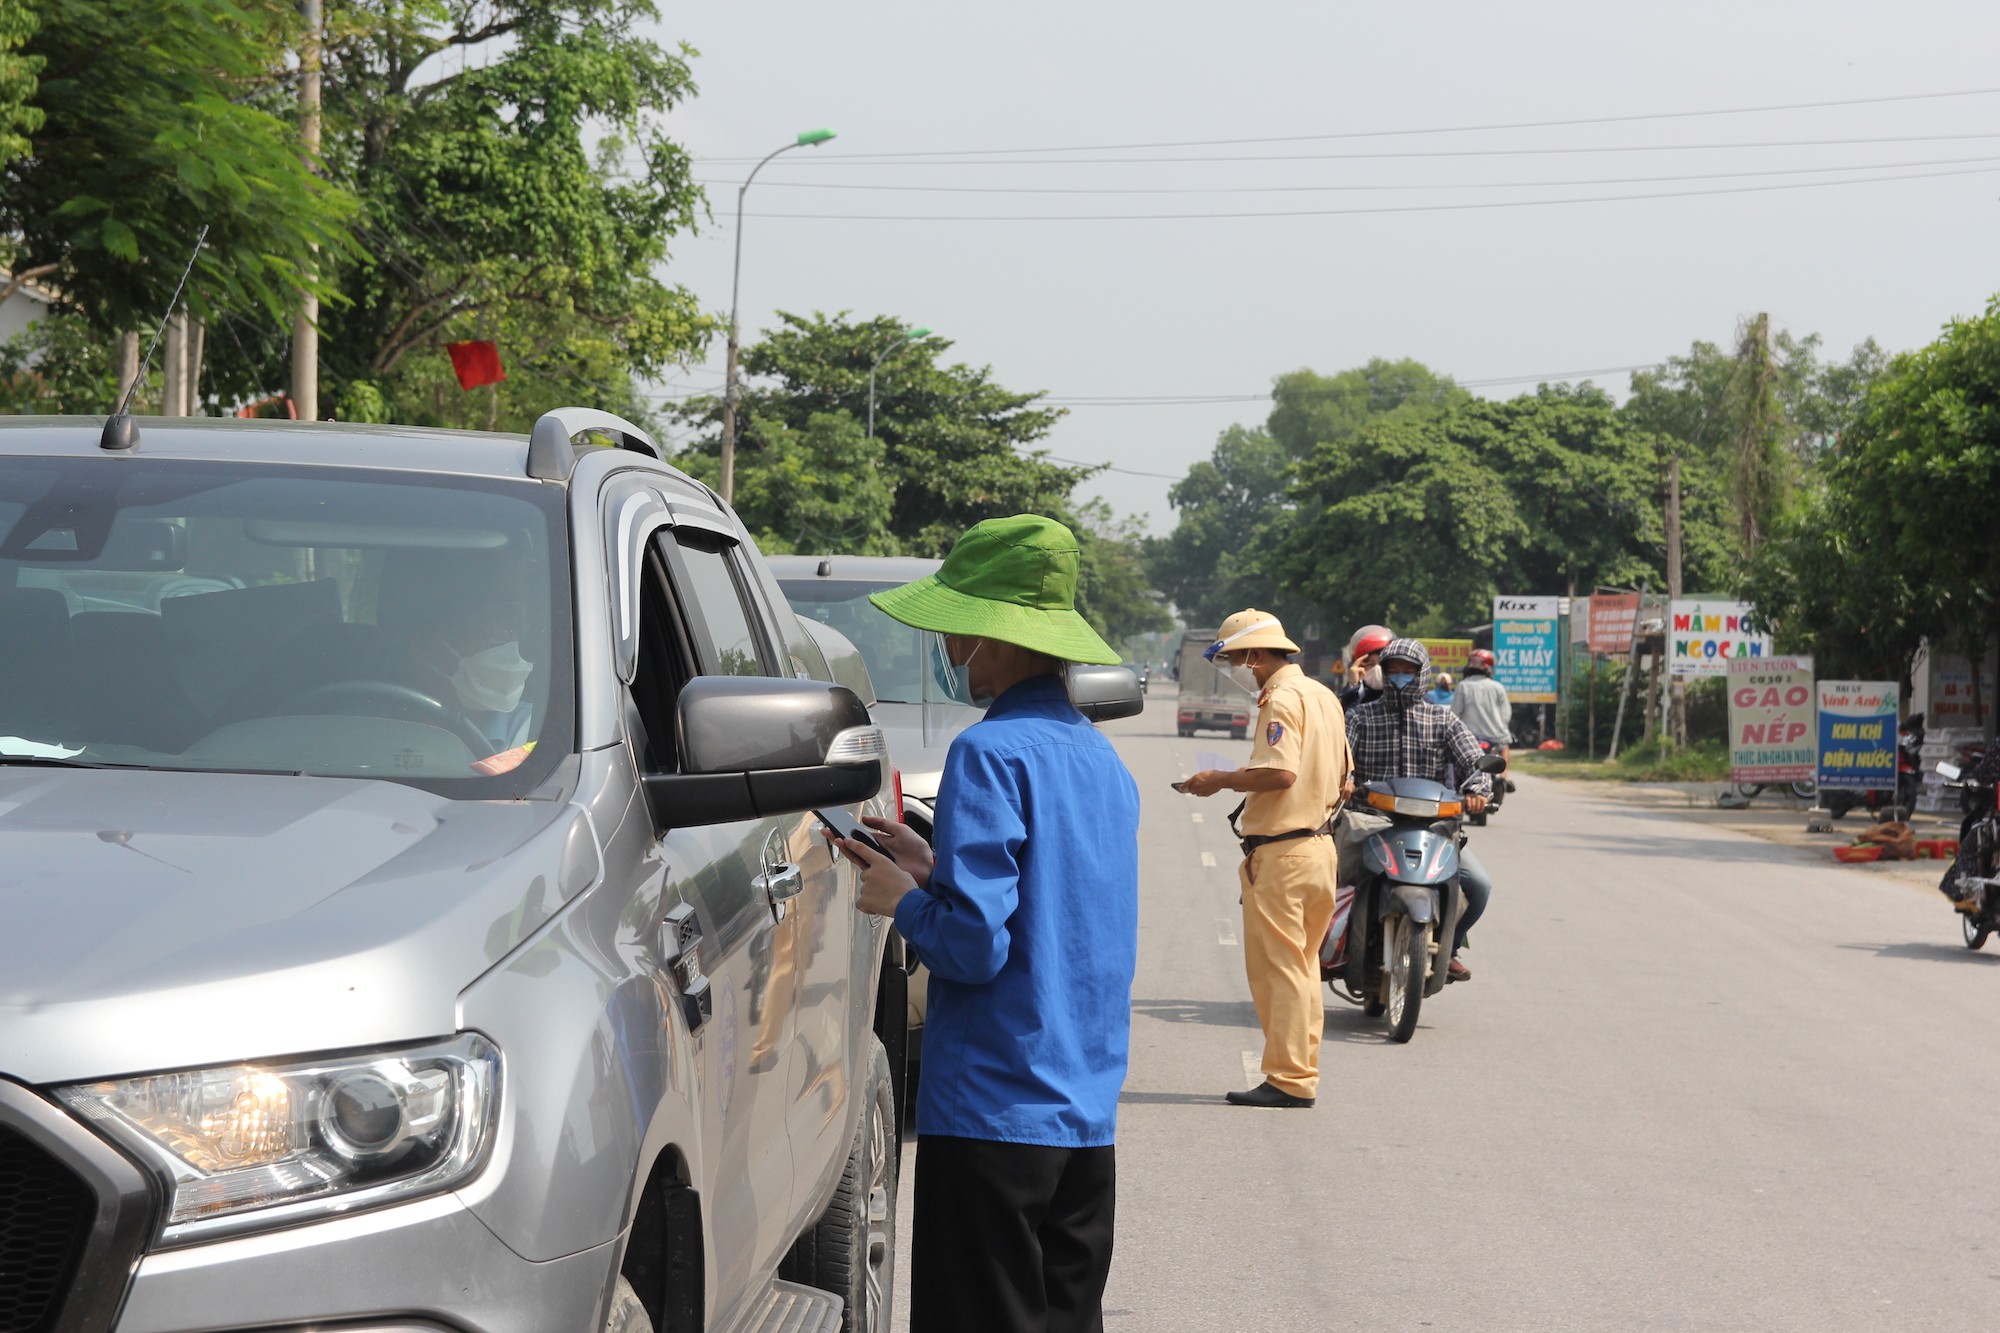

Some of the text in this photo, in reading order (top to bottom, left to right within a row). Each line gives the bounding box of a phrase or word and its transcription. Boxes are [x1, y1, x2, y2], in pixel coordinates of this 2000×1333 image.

[1499, 600, 1538, 610] Kixx
[1674, 604, 1721, 633] MẦM
[1497, 646, 1554, 666] XE MÁY
[1676, 639, 1762, 663] NGỌC AN
[1733, 686, 1809, 713] GẠO
[1741, 713, 1807, 744] NẾP
[1832, 719, 1882, 740] KIM KHÍ
[1823, 748, 1854, 772] ĐIỆN
[1856, 748, 1894, 768] NƯỚC
